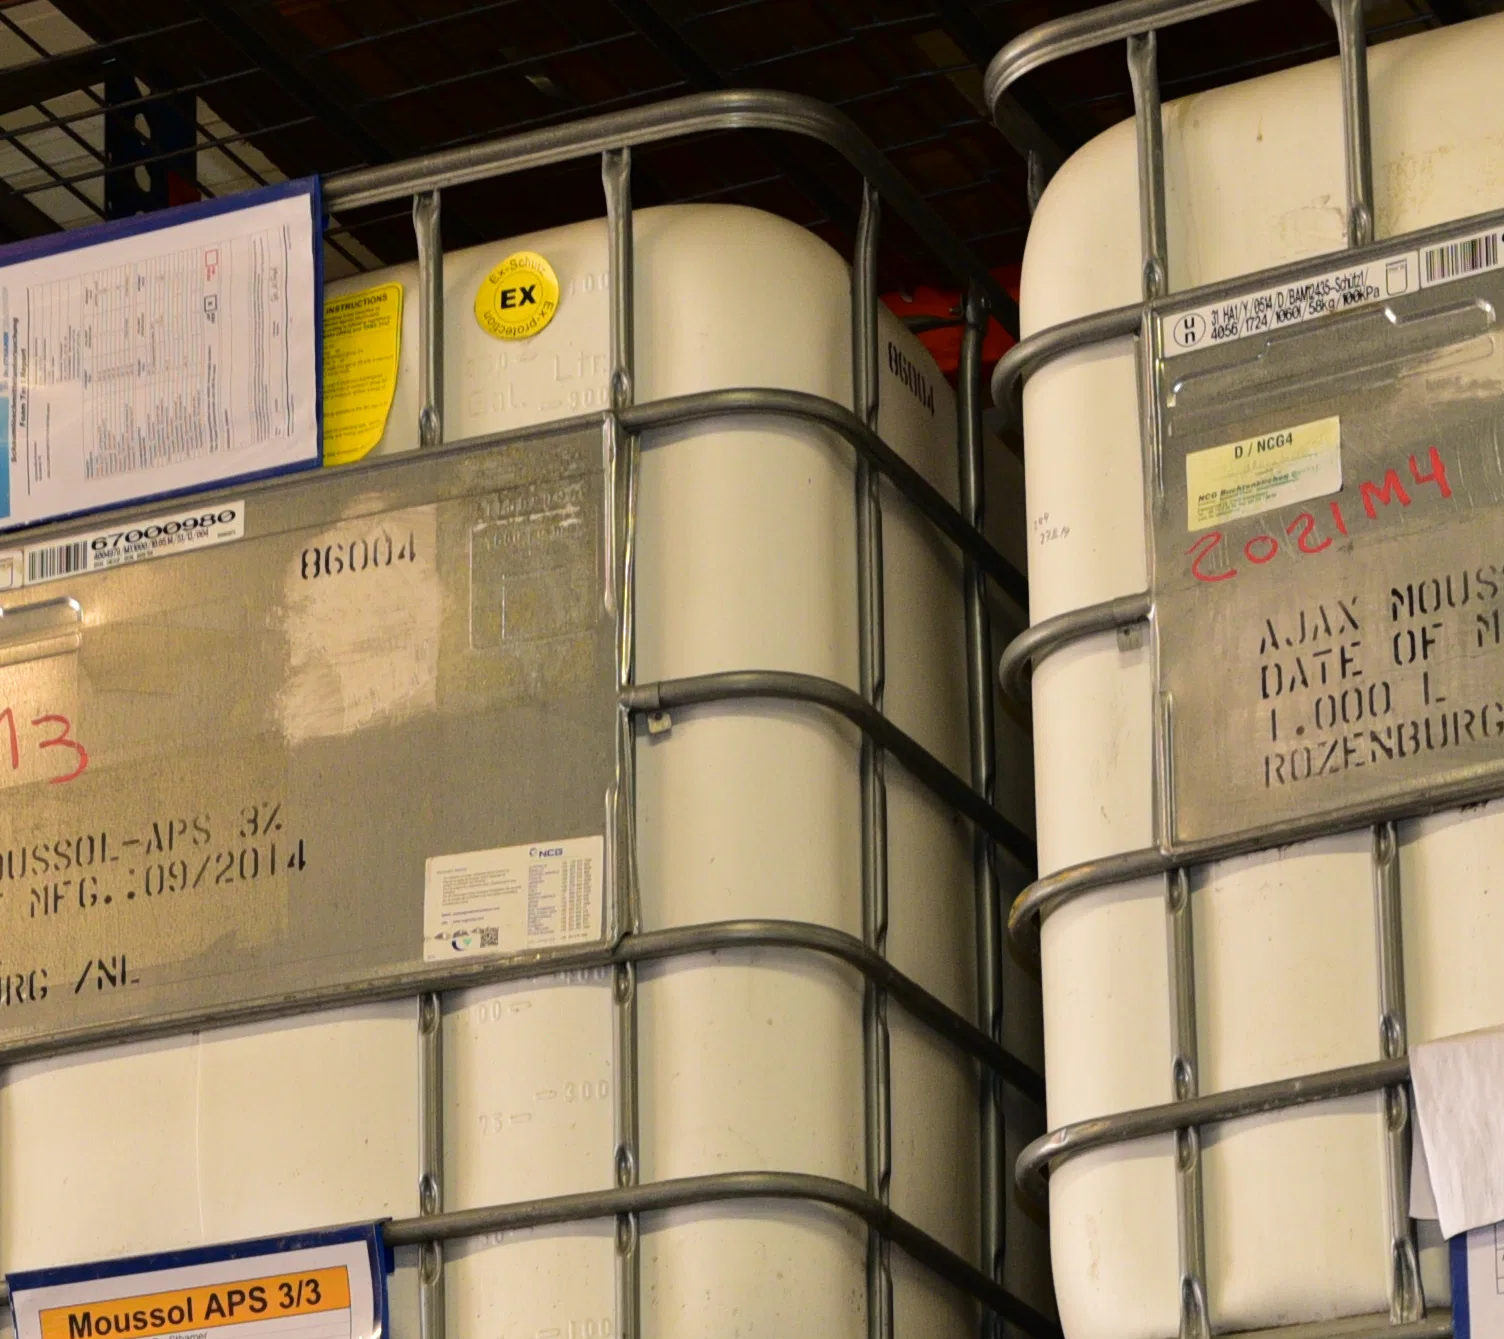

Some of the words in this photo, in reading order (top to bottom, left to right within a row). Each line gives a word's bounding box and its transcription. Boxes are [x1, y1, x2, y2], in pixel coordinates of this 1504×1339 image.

[501, 284, 537, 309] EX
[1257, 432, 1293, 454] NCG4
[91, 510, 236, 551] 67000980
[301, 530, 416, 580] 86004
[1260, 596, 1360, 654] AJAX
[1261, 640, 1362, 699] DATE
[1393, 622, 1443, 665] OF
[1272, 681, 1391, 741] 1.000
[1424, 669, 1446, 703] L
[1264, 702, 1504, 788] ROZENBURG
[240, 803, 283, 838] 3%
[74, 954, 140, 995] /NL
[68, 1297, 193, 1339] Moussol
[204, 1286, 268, 1321] APS
[279, 1278, 322, 1309] 3/3
